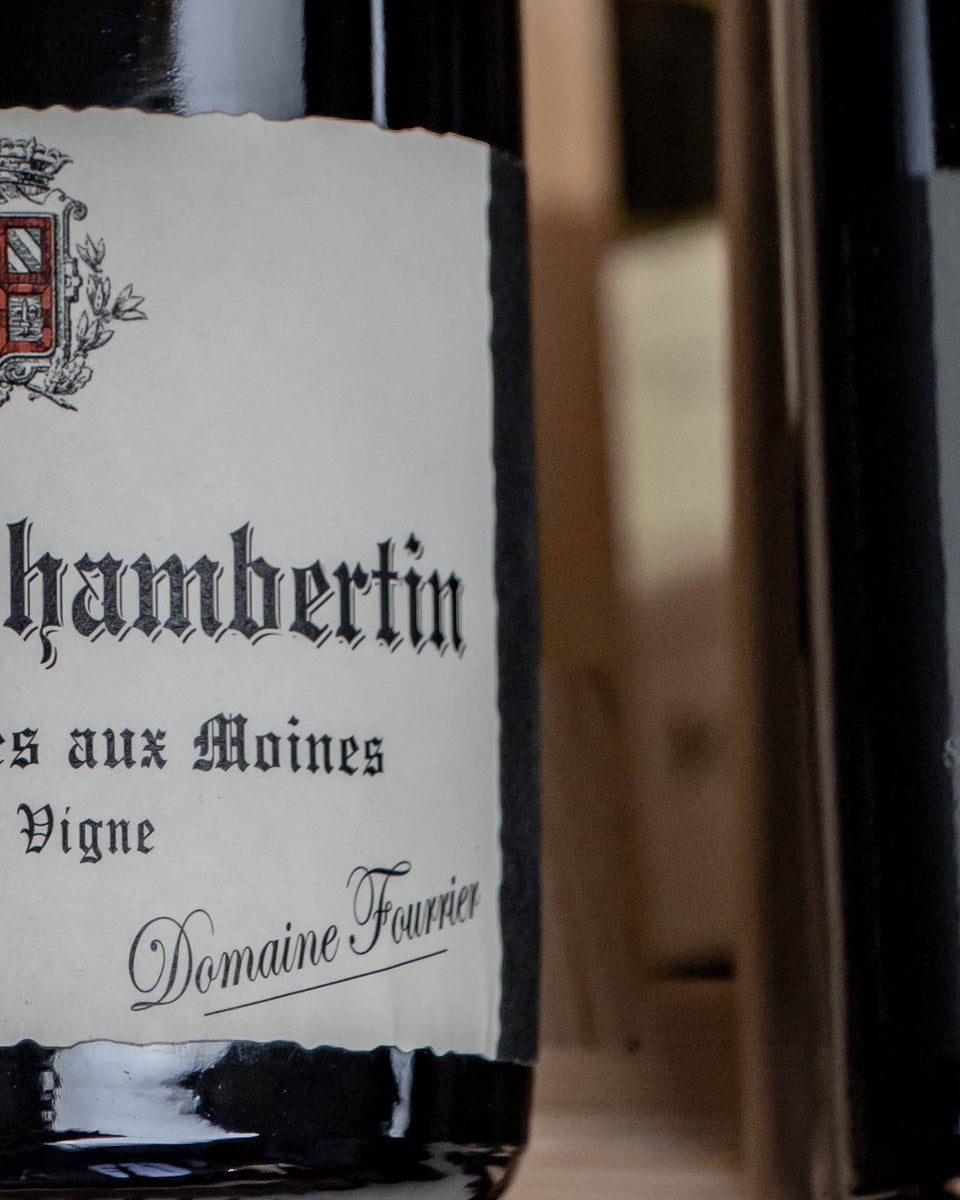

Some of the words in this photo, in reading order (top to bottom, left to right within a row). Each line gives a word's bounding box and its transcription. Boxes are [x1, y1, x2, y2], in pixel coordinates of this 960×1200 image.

[67, 726, 168, 770] aux
[192, 712, 385, 777] Moines
[16, 802, 156, 864] Vigne
[128, 908, 340, 1012] Domaine
[345, 860, 480, 956] Fourrier
